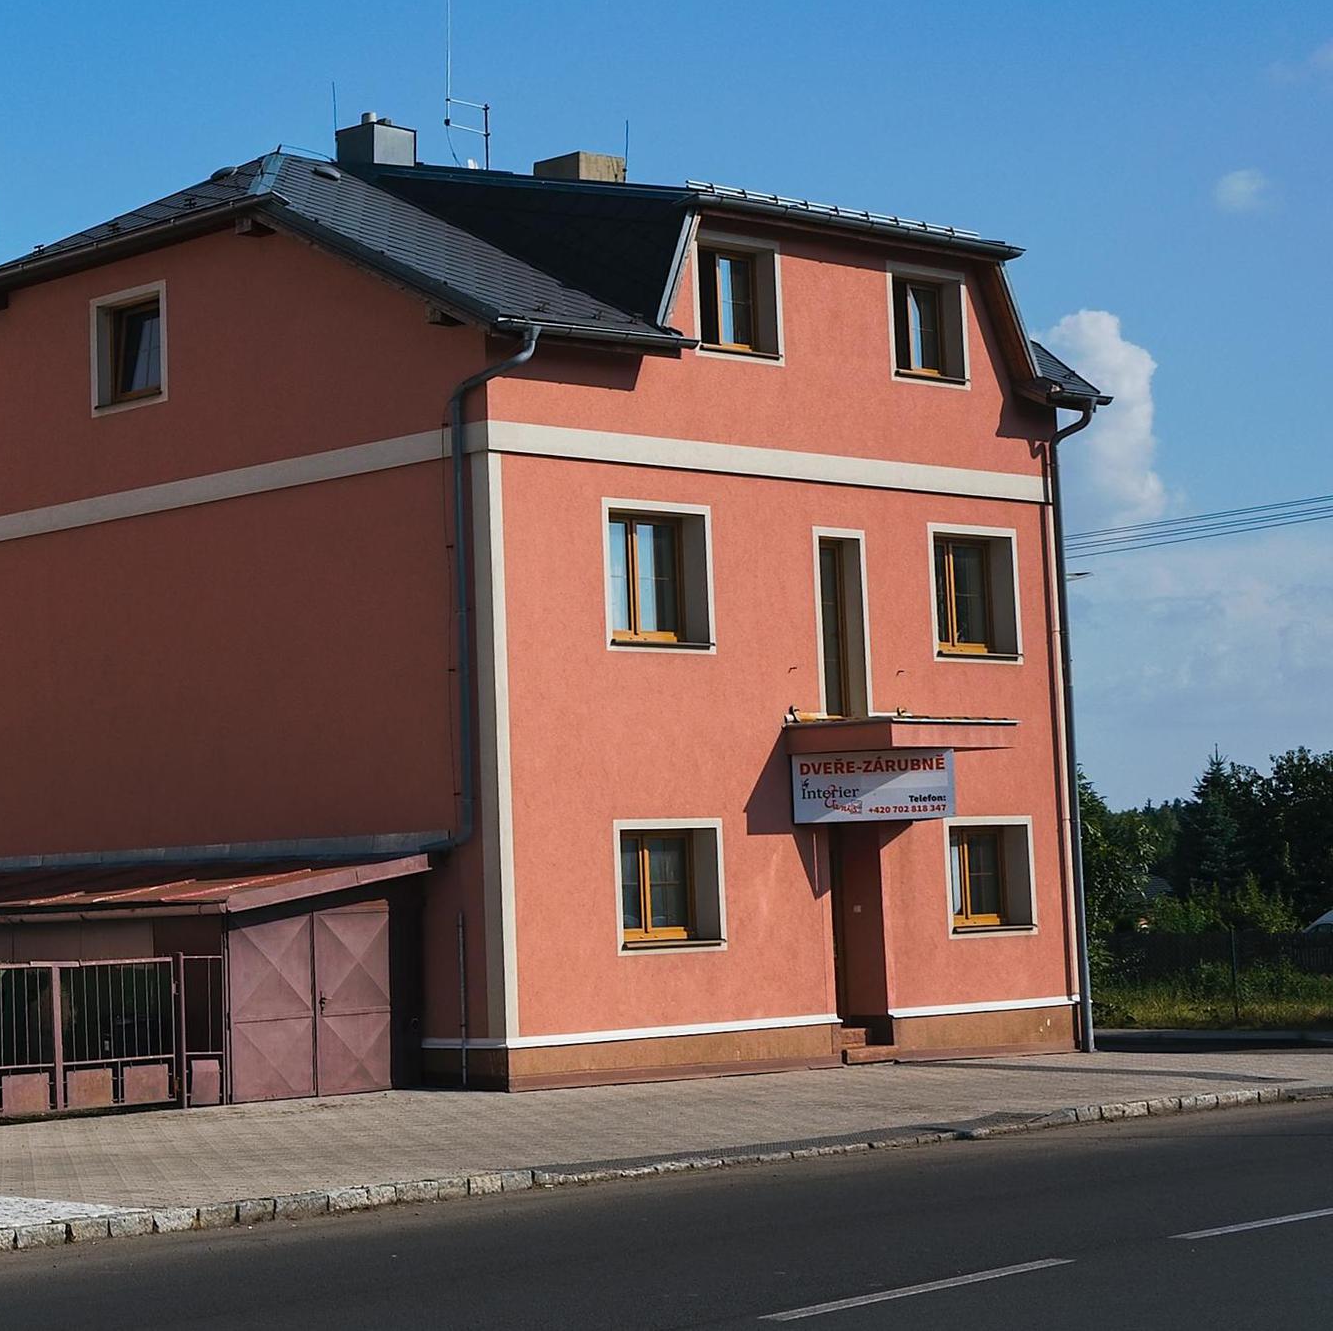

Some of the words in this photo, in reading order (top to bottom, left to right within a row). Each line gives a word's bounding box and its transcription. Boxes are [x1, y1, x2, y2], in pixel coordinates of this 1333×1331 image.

[799, 754, 946, 775] DVEŘE-ZÁRUBNĚ
[908, 793, 947, 803] Telefon:
[868, 805, 891, 814] +420
[893, 805, 910, 813] 702
